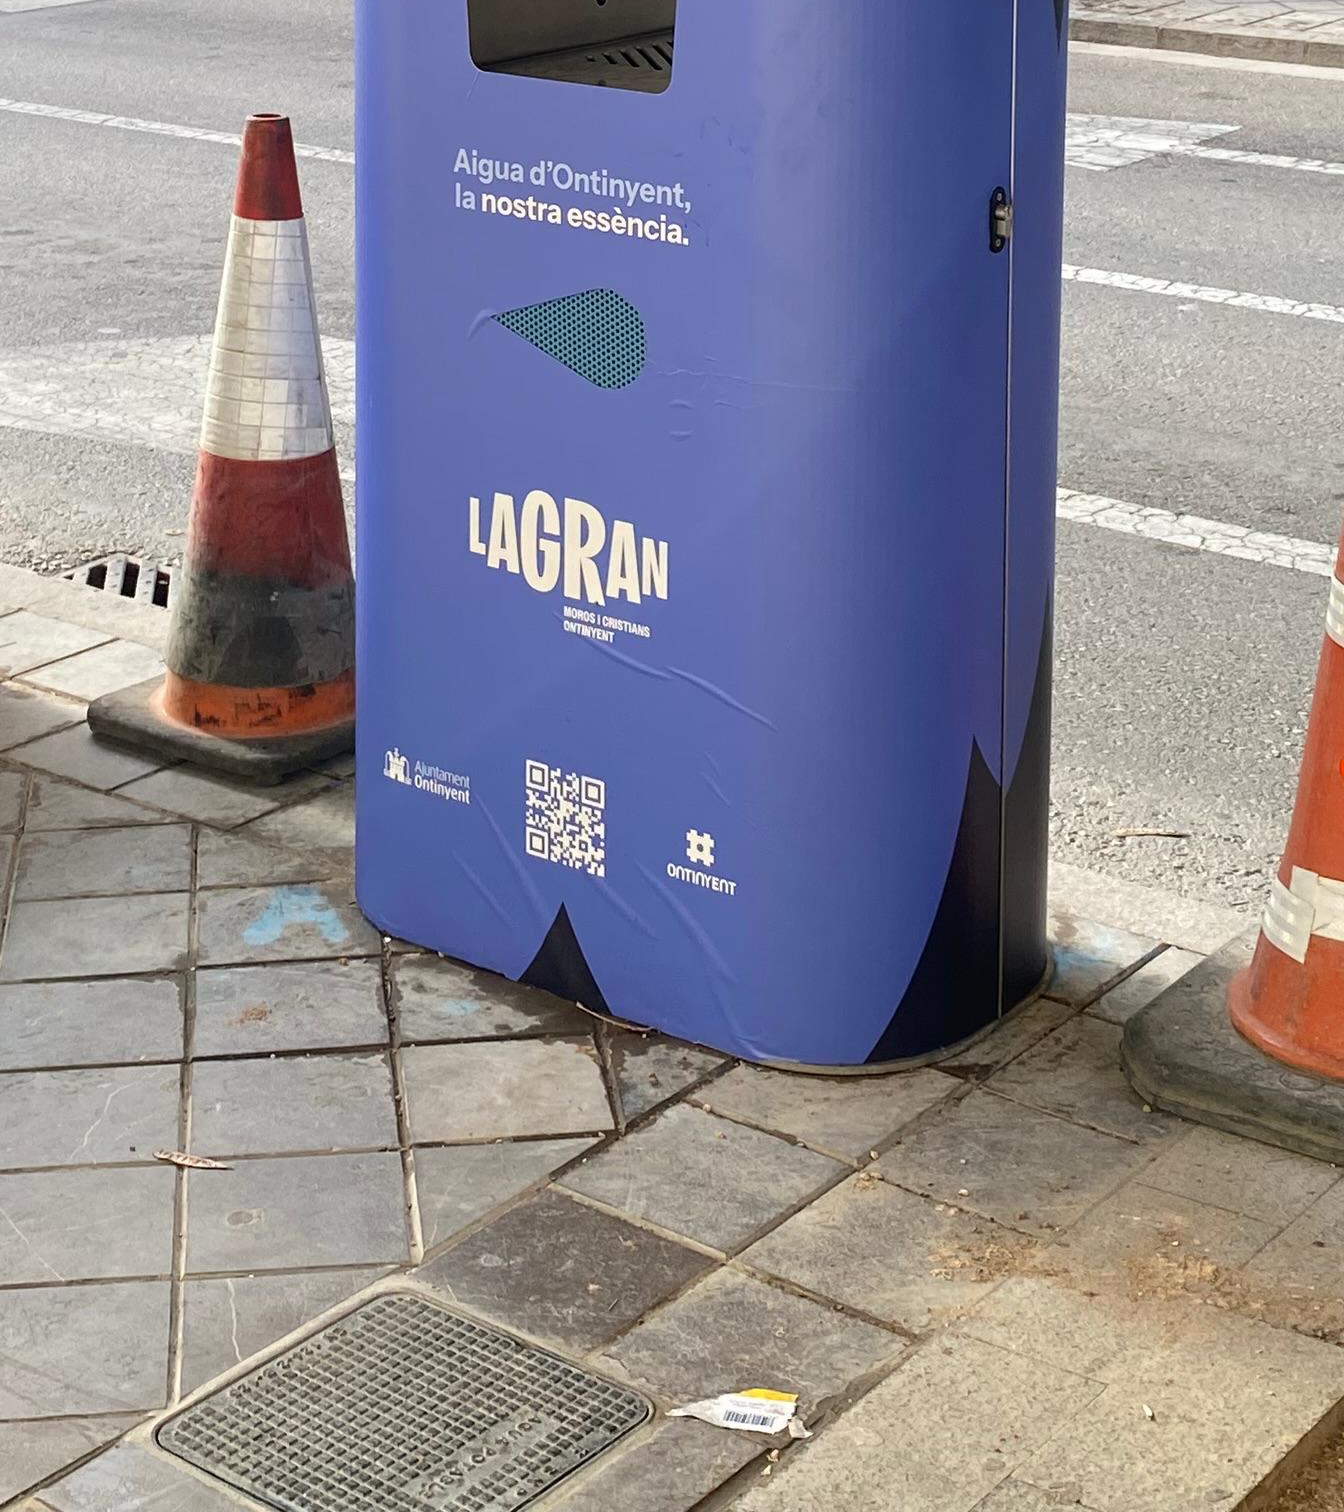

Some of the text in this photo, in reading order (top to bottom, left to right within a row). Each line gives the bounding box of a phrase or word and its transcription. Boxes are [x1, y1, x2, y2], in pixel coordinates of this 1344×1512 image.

[453, 148, 692, 214] Aigua d’Ontinyent,
[455, 182, 689, 246] la nostra essència.
[563, 605, 596, 625] MOROS
[602, 615, 651, 638] CRISTIANS
[563, 620, 615, 643] ONTINYENT
[414, 774, 470, 805] Ontinyent
[415, 760, 470, 790] Ajuntament
